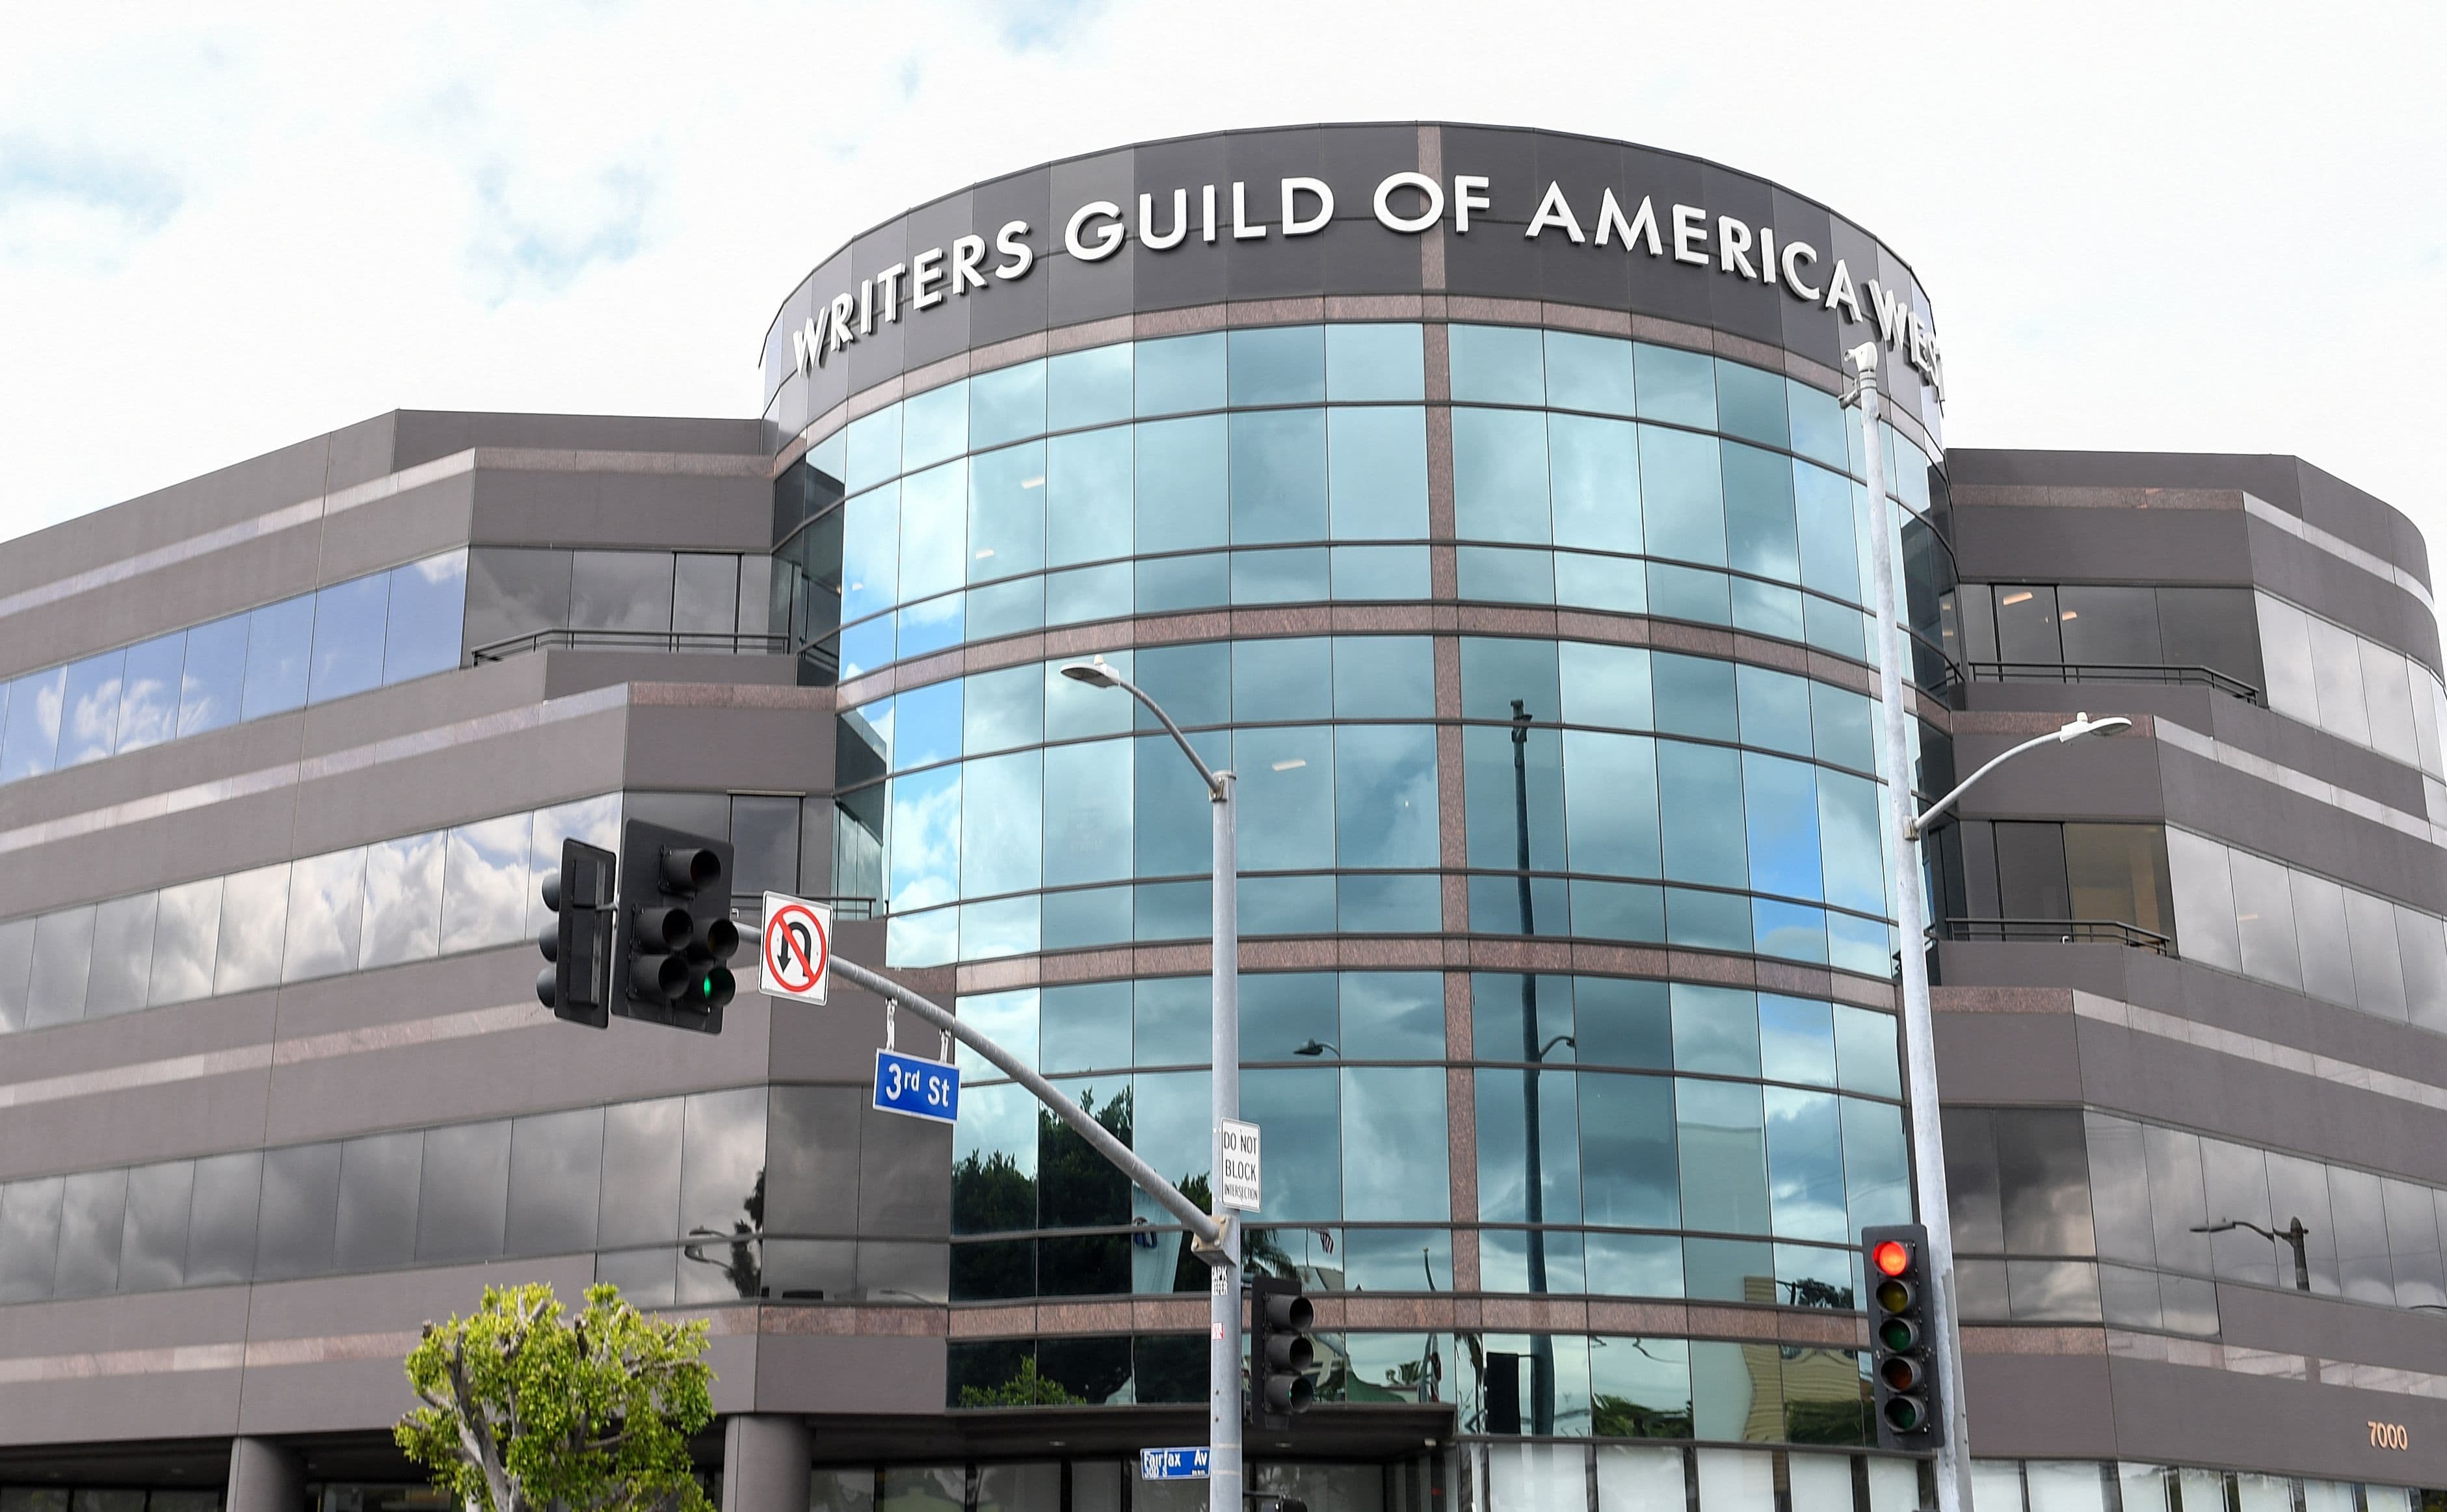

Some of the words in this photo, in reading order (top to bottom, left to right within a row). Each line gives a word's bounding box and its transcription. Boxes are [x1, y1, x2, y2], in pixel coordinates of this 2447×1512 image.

[793, 220, 1033, 378] WRITERS
[1065, 176, 1335, 261] GUILD
[1373, 171, 1490, 234] OF
[1525, 180, 1864, 324] AMERICA
[886, 1063, 920, 1101] 3rd
[928, 1076, 949, 1107] St
[1224, 1132, 1237, 1150] DO
[1240, 1134, 1258, 1155] NOT
[1225, 1159, 1256, 1182] BLOCK
[1224, 1184, 1258, 1200] INTERSECTION
[2368, 1421, 2408, 1451] 7000
[1144, 1450, 1181, 1467] Fairfax
[1194, 1449, 1208, 1466] Av
